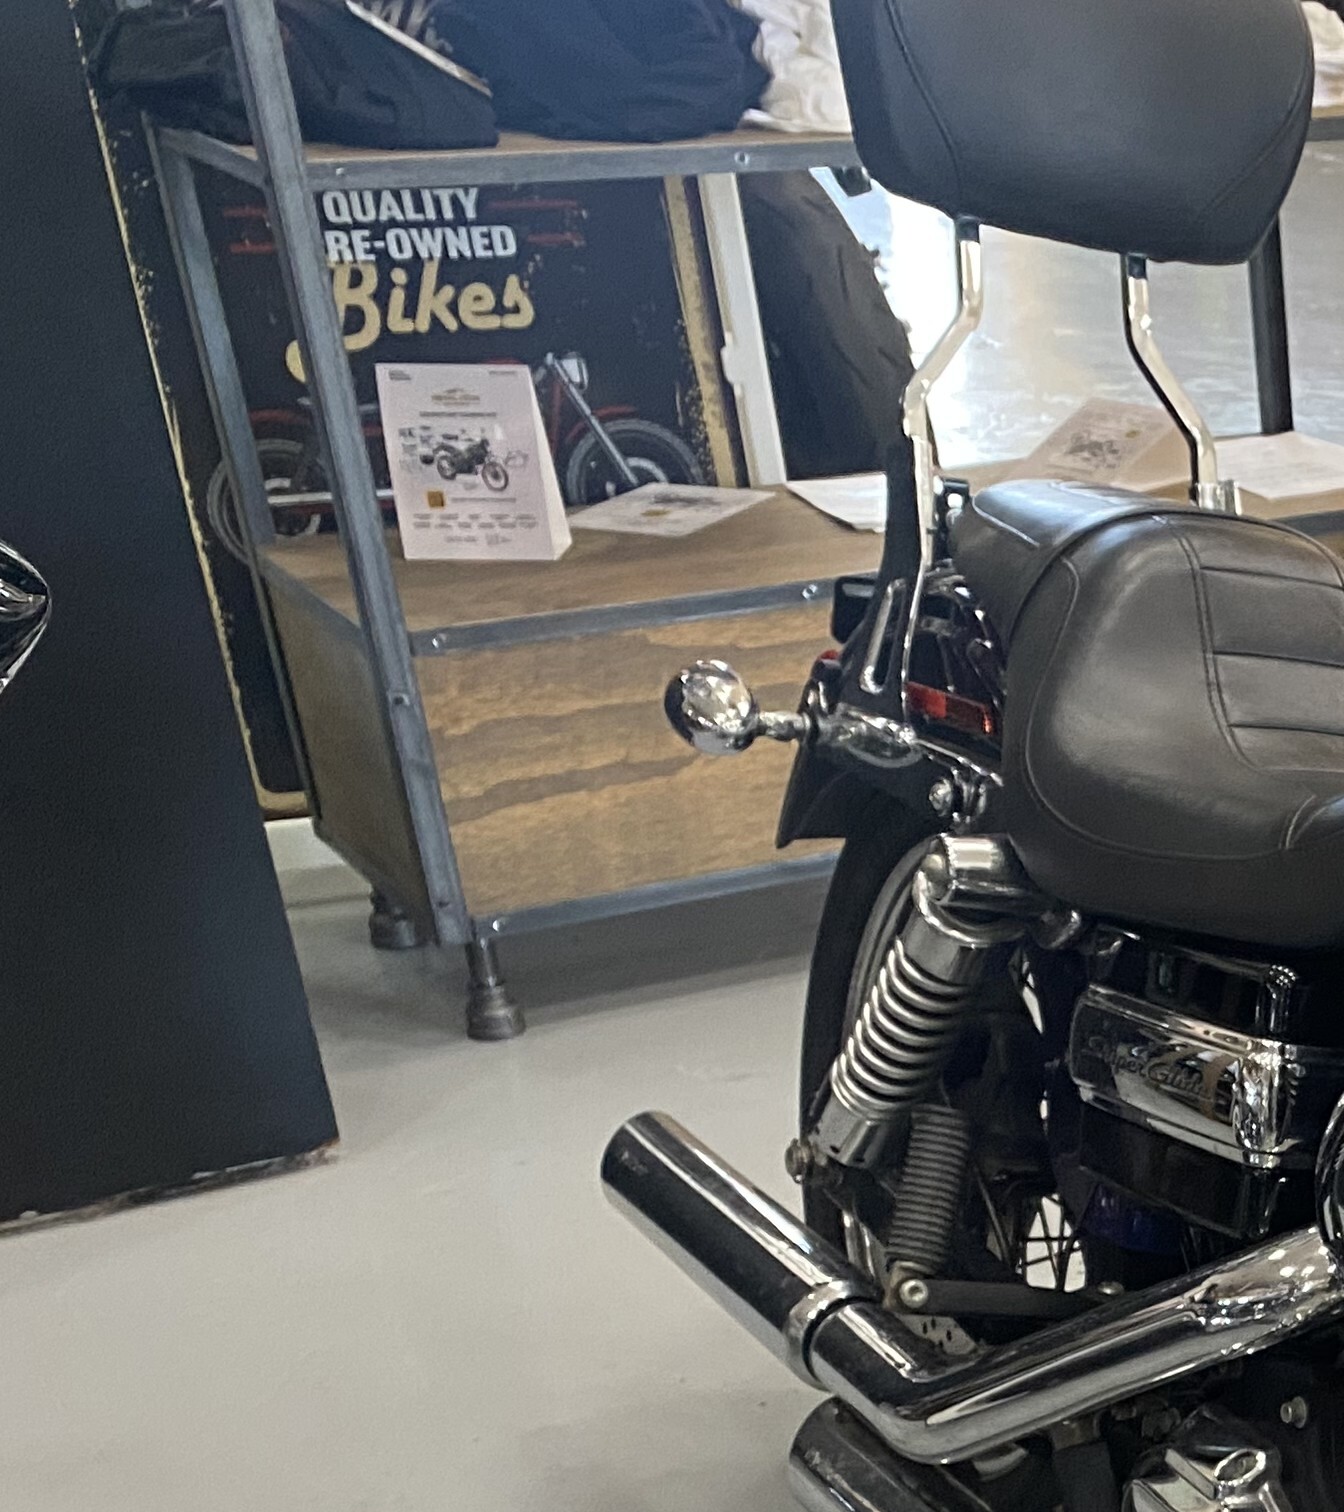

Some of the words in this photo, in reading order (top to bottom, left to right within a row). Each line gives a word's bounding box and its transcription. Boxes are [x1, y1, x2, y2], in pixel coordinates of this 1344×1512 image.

[322, 187, 478, 225] QUALITY
[323, 224, 517, 263] RE-OWNED
[325, 256, 535, 354] Bikes
